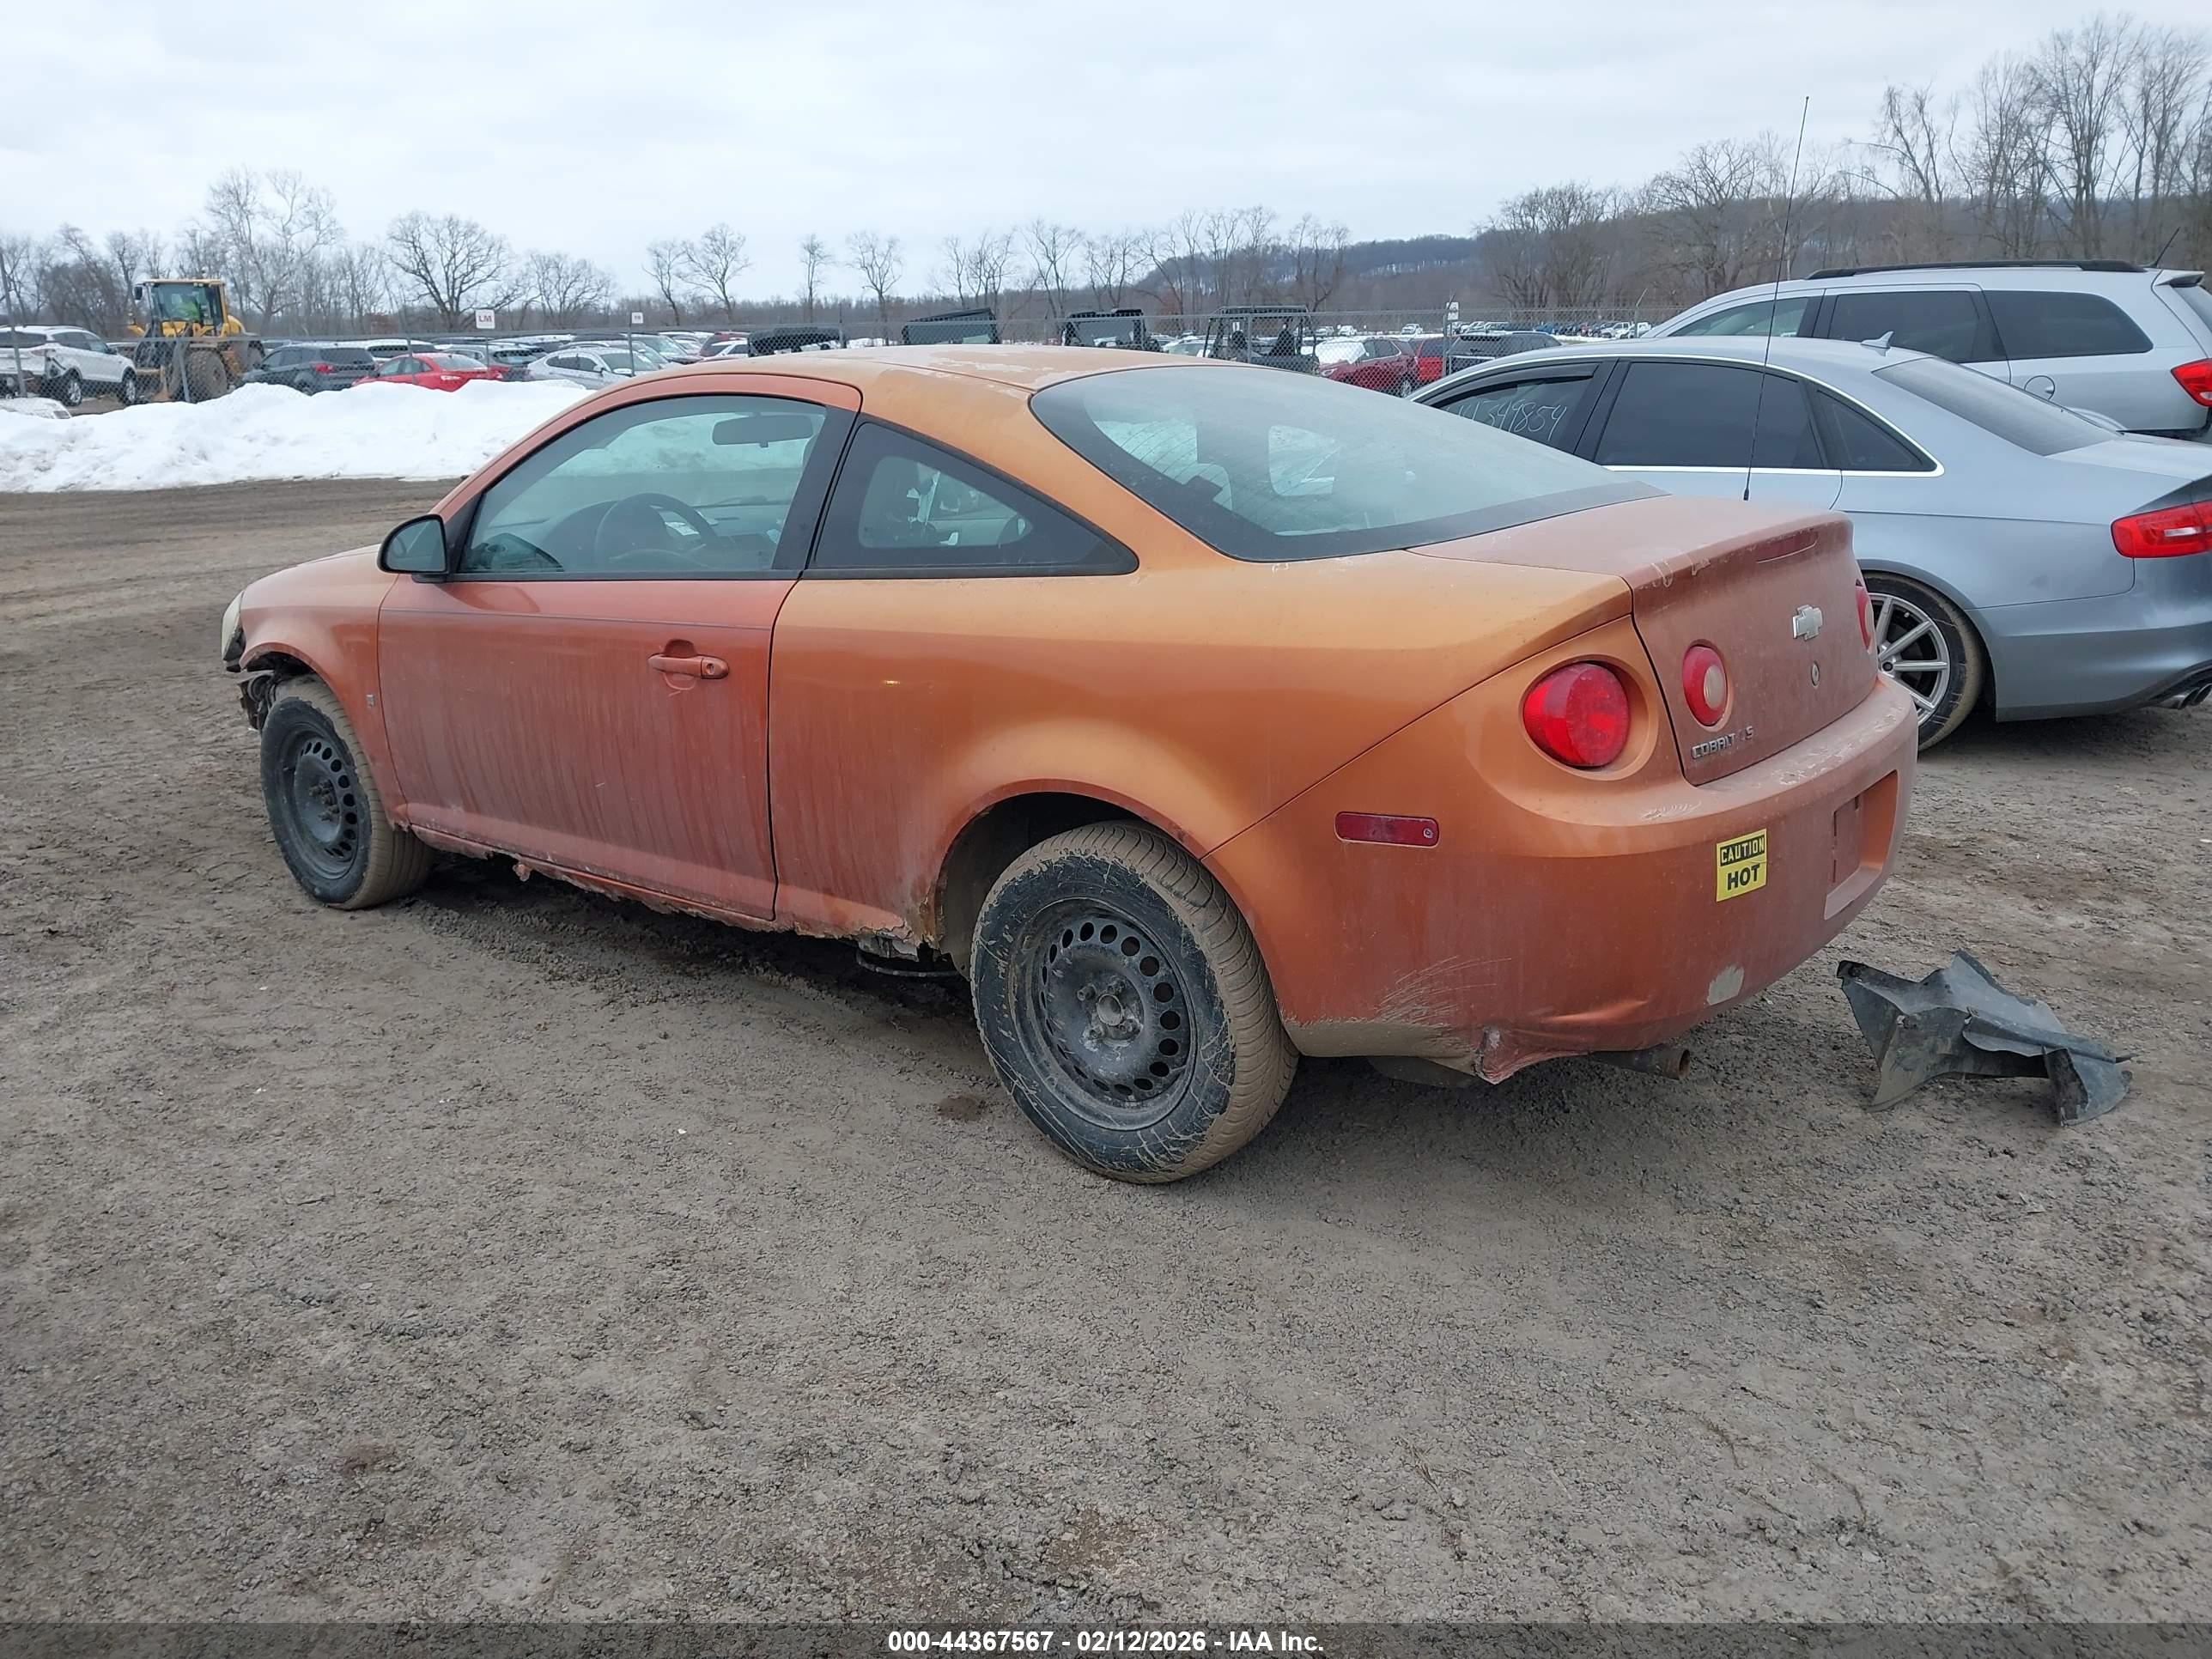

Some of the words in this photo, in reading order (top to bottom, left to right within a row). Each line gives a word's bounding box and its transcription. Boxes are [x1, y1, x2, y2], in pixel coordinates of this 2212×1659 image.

[1692, 733, 1736, 758] COBALT
[1721, 836, 1765, 864] CAUTION
[1727, 863, 1760, 890] HOT
